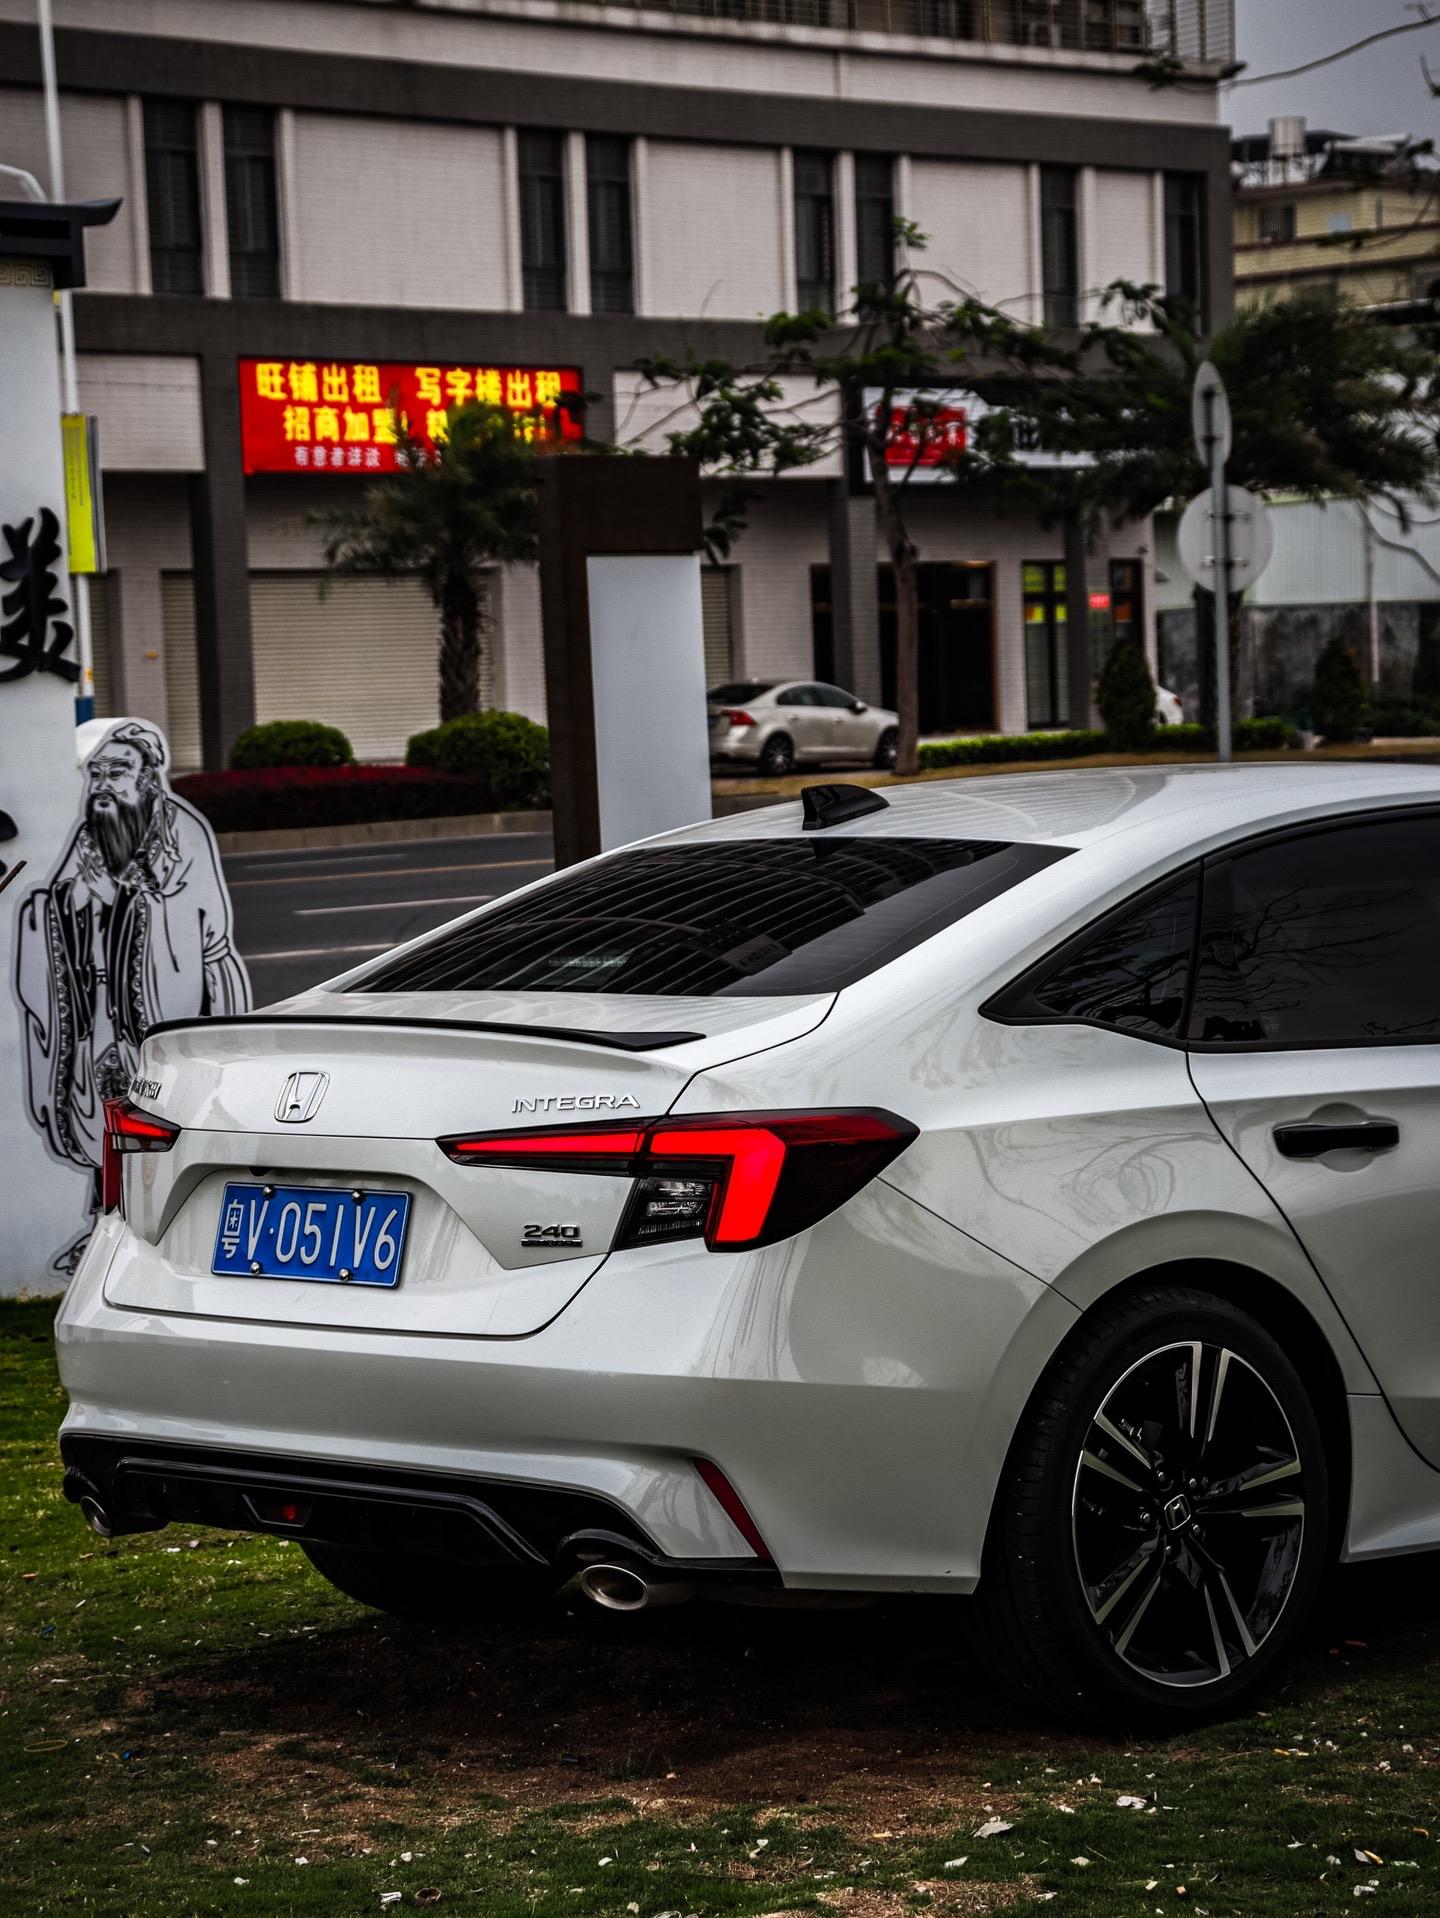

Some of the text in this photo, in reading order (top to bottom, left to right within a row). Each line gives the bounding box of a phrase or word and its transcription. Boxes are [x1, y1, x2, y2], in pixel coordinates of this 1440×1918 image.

[256, 361, 561, 409] 旺铺出租 写字楼出租
[511, 1093, 641, 1114] INTEGRA
[523, 1223, 581, 1239] 240
